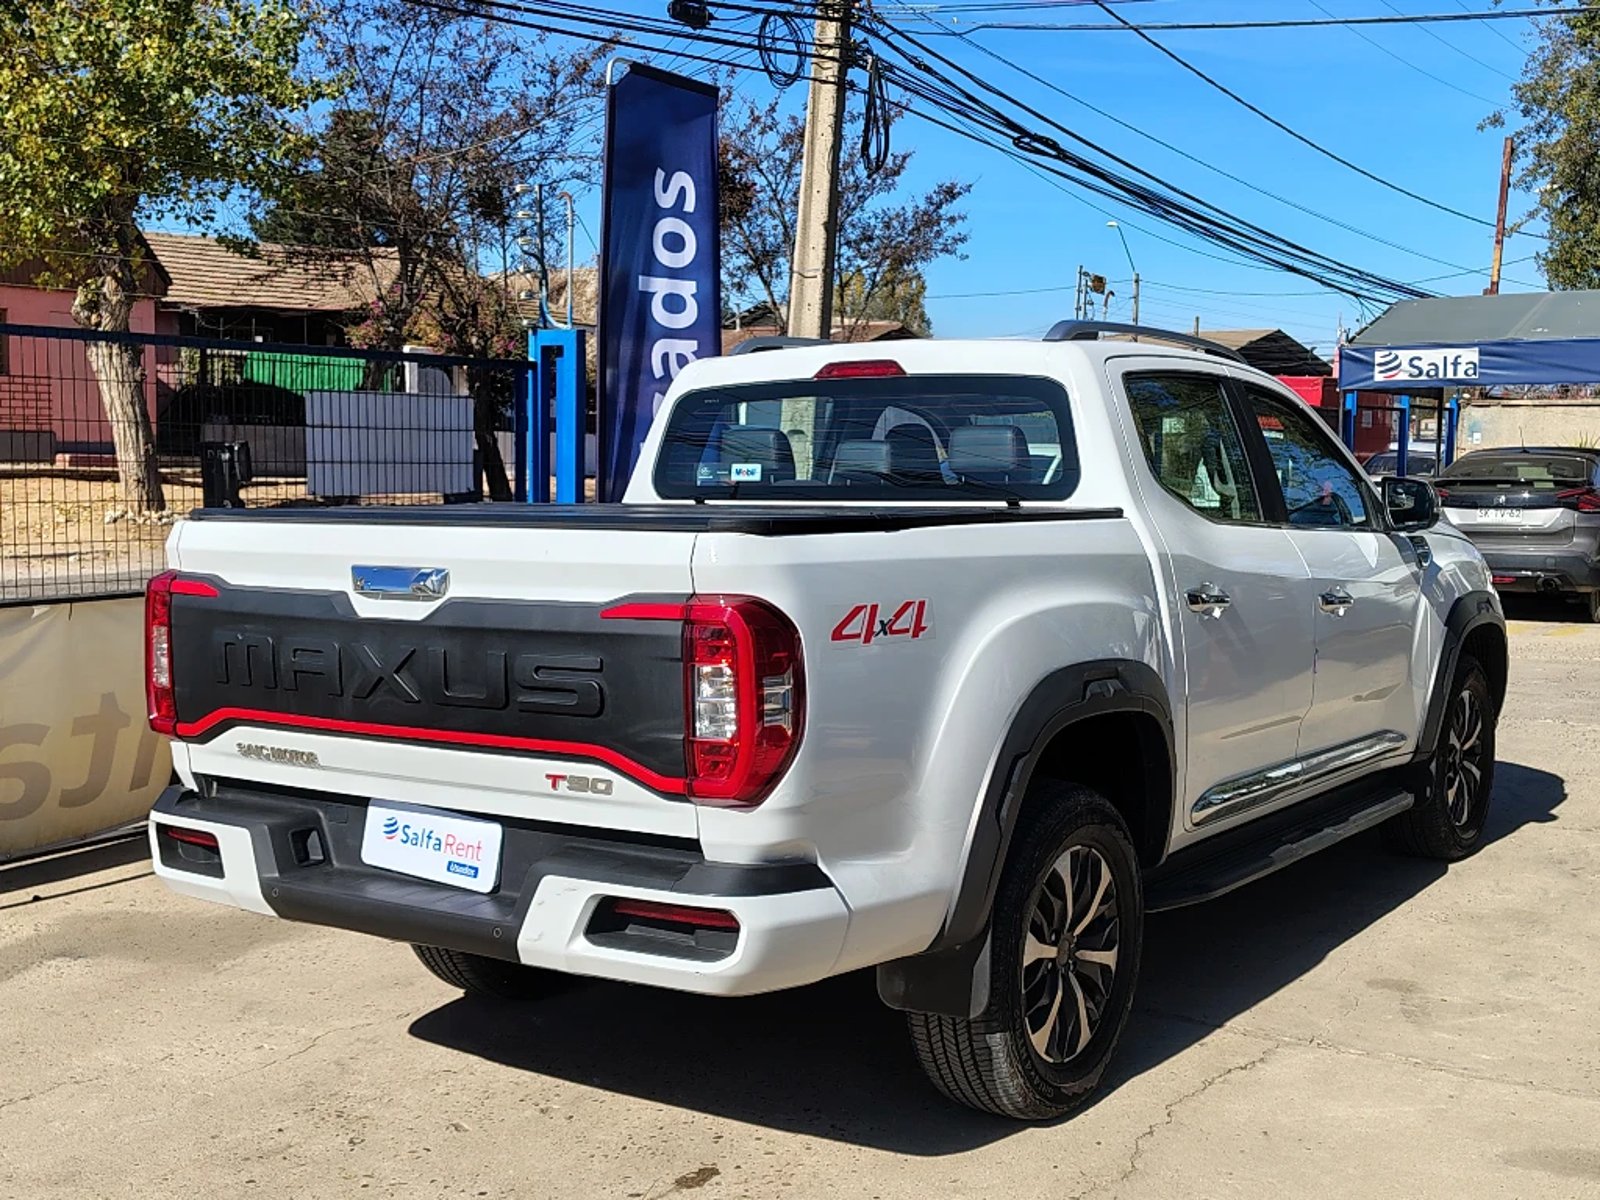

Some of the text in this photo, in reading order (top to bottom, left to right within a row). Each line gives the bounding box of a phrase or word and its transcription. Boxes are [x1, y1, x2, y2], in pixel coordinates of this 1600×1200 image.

[639, 167, 699, 450] ados
[1408, 355, 1478, 378] Salfa
[831, 600, 928, 644] 4x4
[212, 625, 605, 718] MAXUS
[545, 773, 613, 795] T90
[400, 824, 482, 861] SalfaRent
